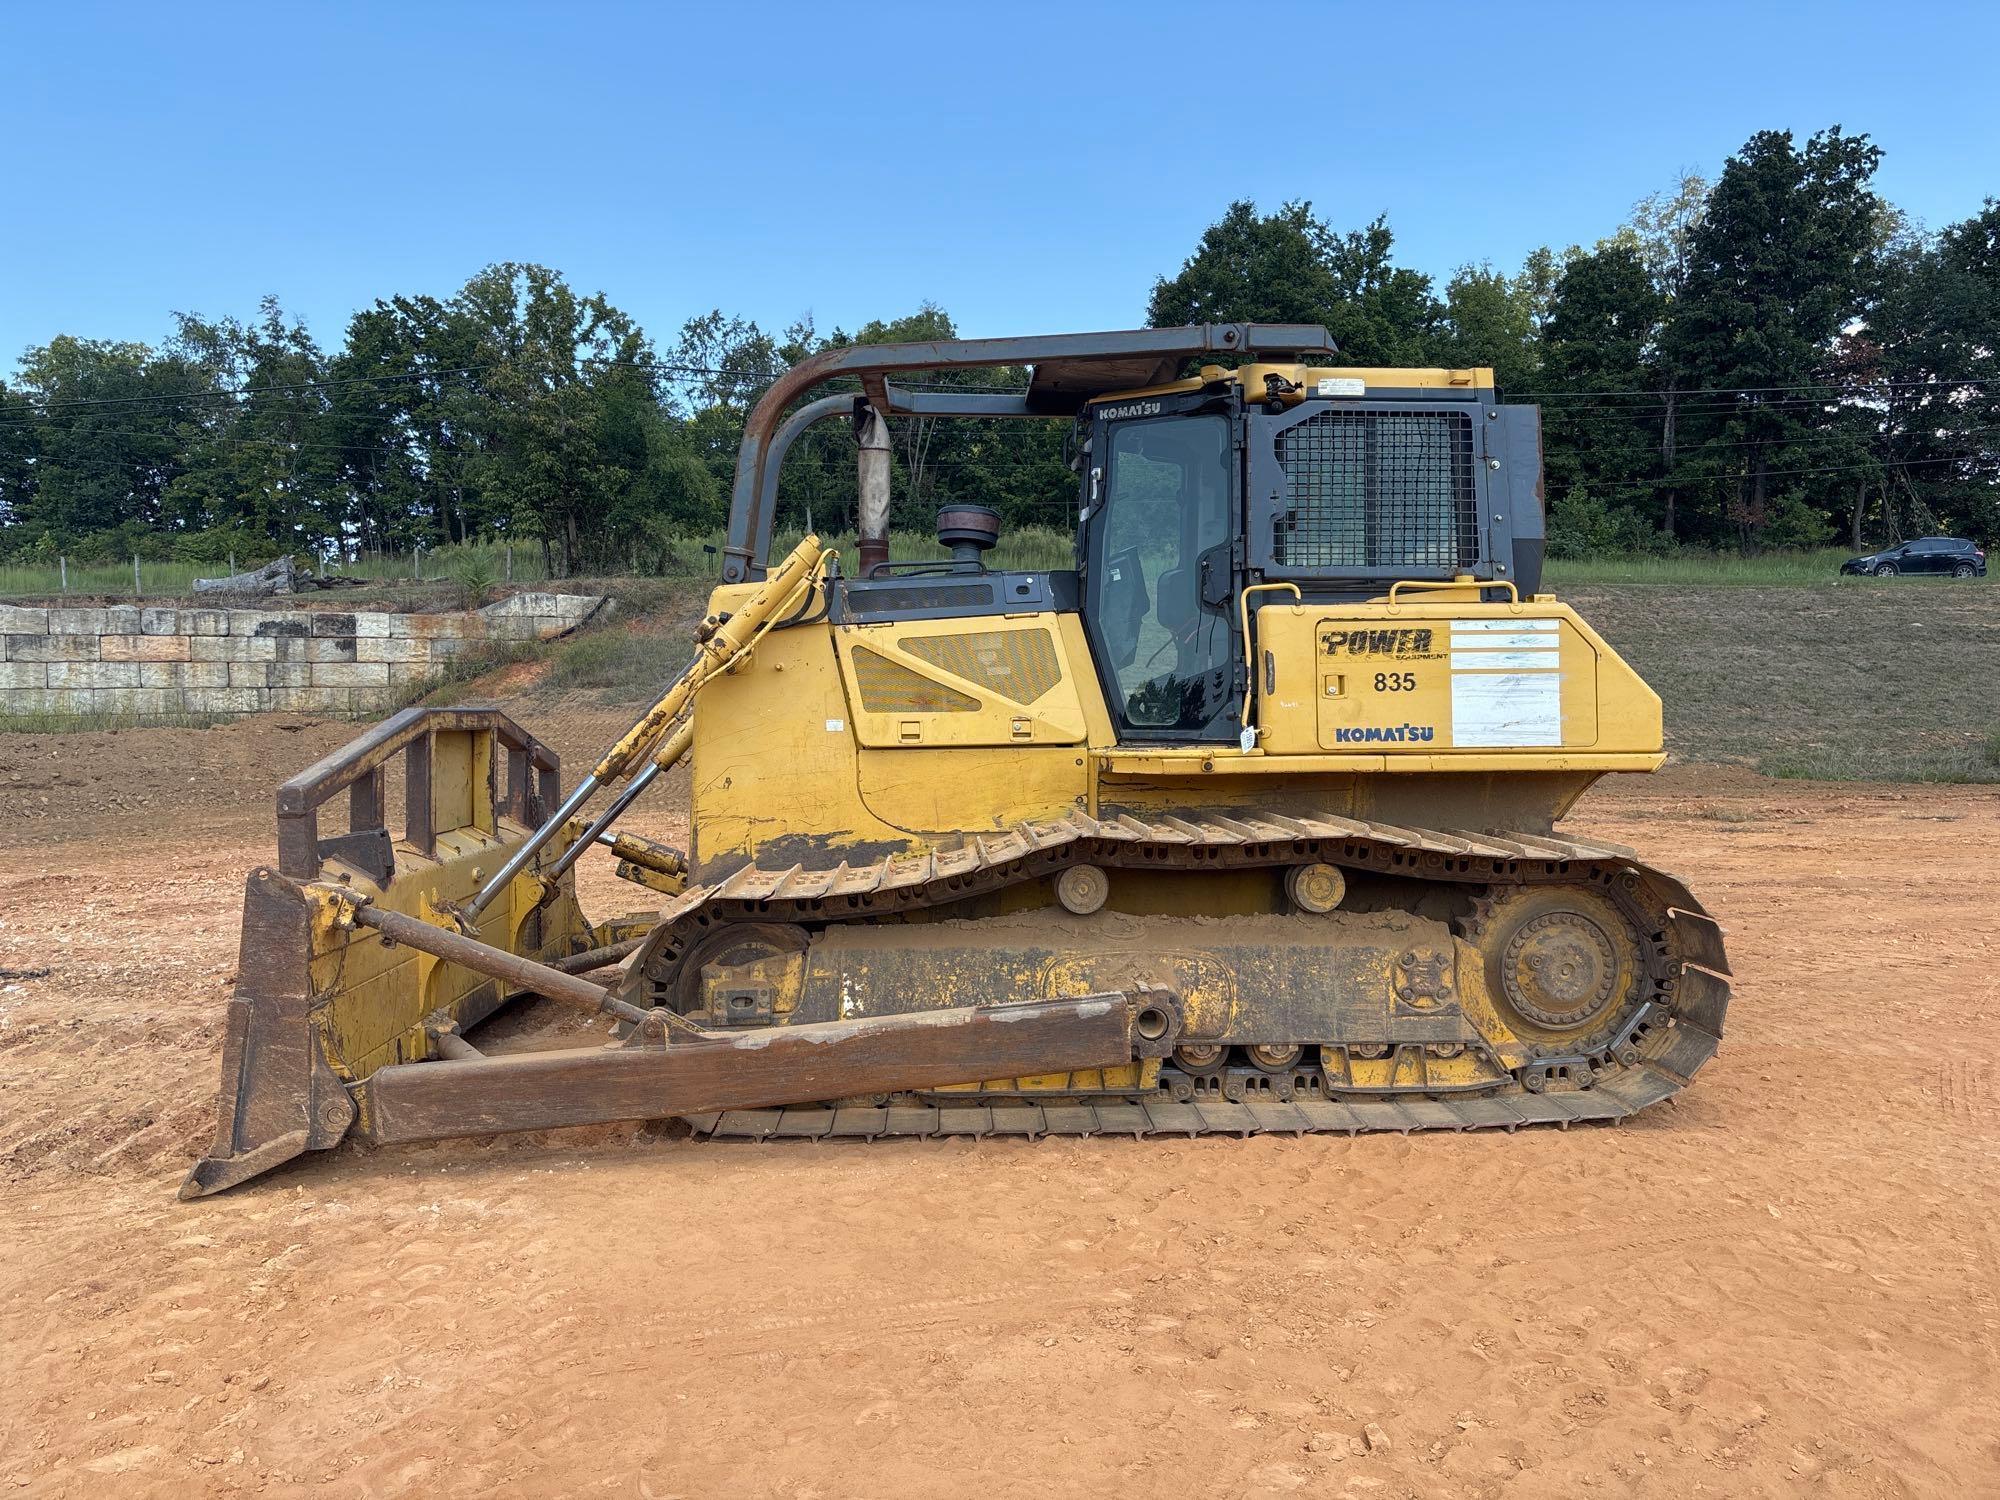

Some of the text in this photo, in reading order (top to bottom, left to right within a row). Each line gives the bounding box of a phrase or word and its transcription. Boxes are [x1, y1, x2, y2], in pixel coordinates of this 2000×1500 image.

[1099, 402, 1160, 420] KOMATSU
[1321, 629, 1432, 655] POWER
[1374, 673, 1416, 692] 835
[1336, 723, 1433, 742] KOMATSU
